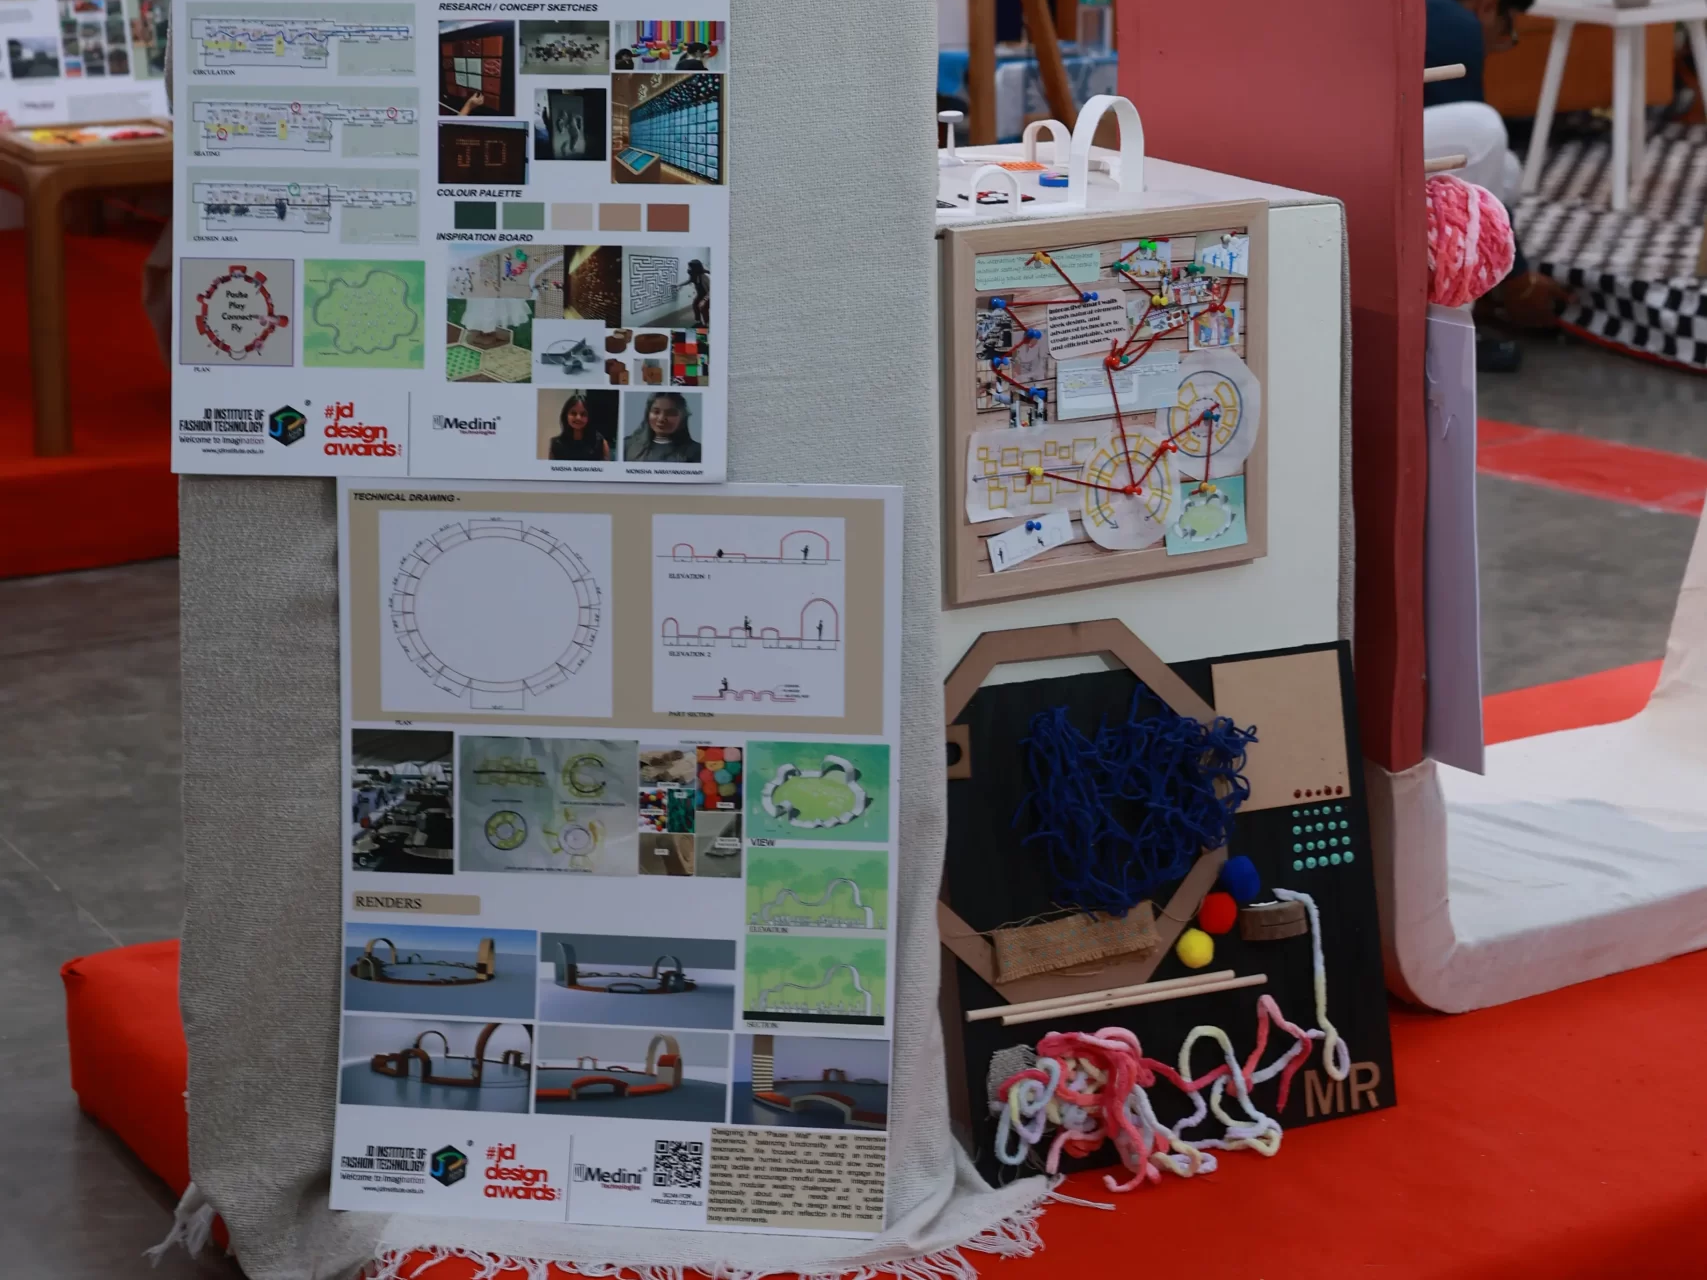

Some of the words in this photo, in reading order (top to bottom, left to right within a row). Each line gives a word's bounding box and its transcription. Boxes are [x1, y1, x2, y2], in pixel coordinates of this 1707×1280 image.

[438, 2, 492, 10] RESEARCH
[499, 3, 545, 11] CONCEPT
[547, 3, 598, 11] SKETCHES
[436, 188, 477, 196] COLOUR
[478, 189, 522, 197] PALETTE
[436, 232, 496, 241] INSPIRATION
[498, 233, 533, 241] BOARD
[228, 301, 245, 311] Play
[221, 312, 253, 321] Connect
[231, 323, 243, 333] Fly
[1051, 342, 1063, 351] and
[203, 408, 212, 420] JD
[213, 408, 253, 421] INSTITUTE
[254, 408, 265, 421] OF
[179, 420, 212, 432] FASHION
[213, 420, 265, 433] TECHNOLOGY
[444, 418, 496, 430] Medini
[323, 422, 387, 443] design
[179, 435, 211, 444] Welcome
[213, 436, 220, 444] to
[222, 435, 264, 446] Imagination
[323, 441, 396, 457] awards
[352, 492, 406, 501] TECHNICAL
[407, 493, 455, 502] DRAWING
[750, 838, 776, 847] VIEW
[354, 896, 423, 909] RENDERS
[1303, 1061, 1380, 1118] MR
[416, 1147, 428, 1159] OF
[485, 1164, 548, 1186] design
[585, 1167, 641, 1184] Medini
[484, 1184, 556, 1201] awards
